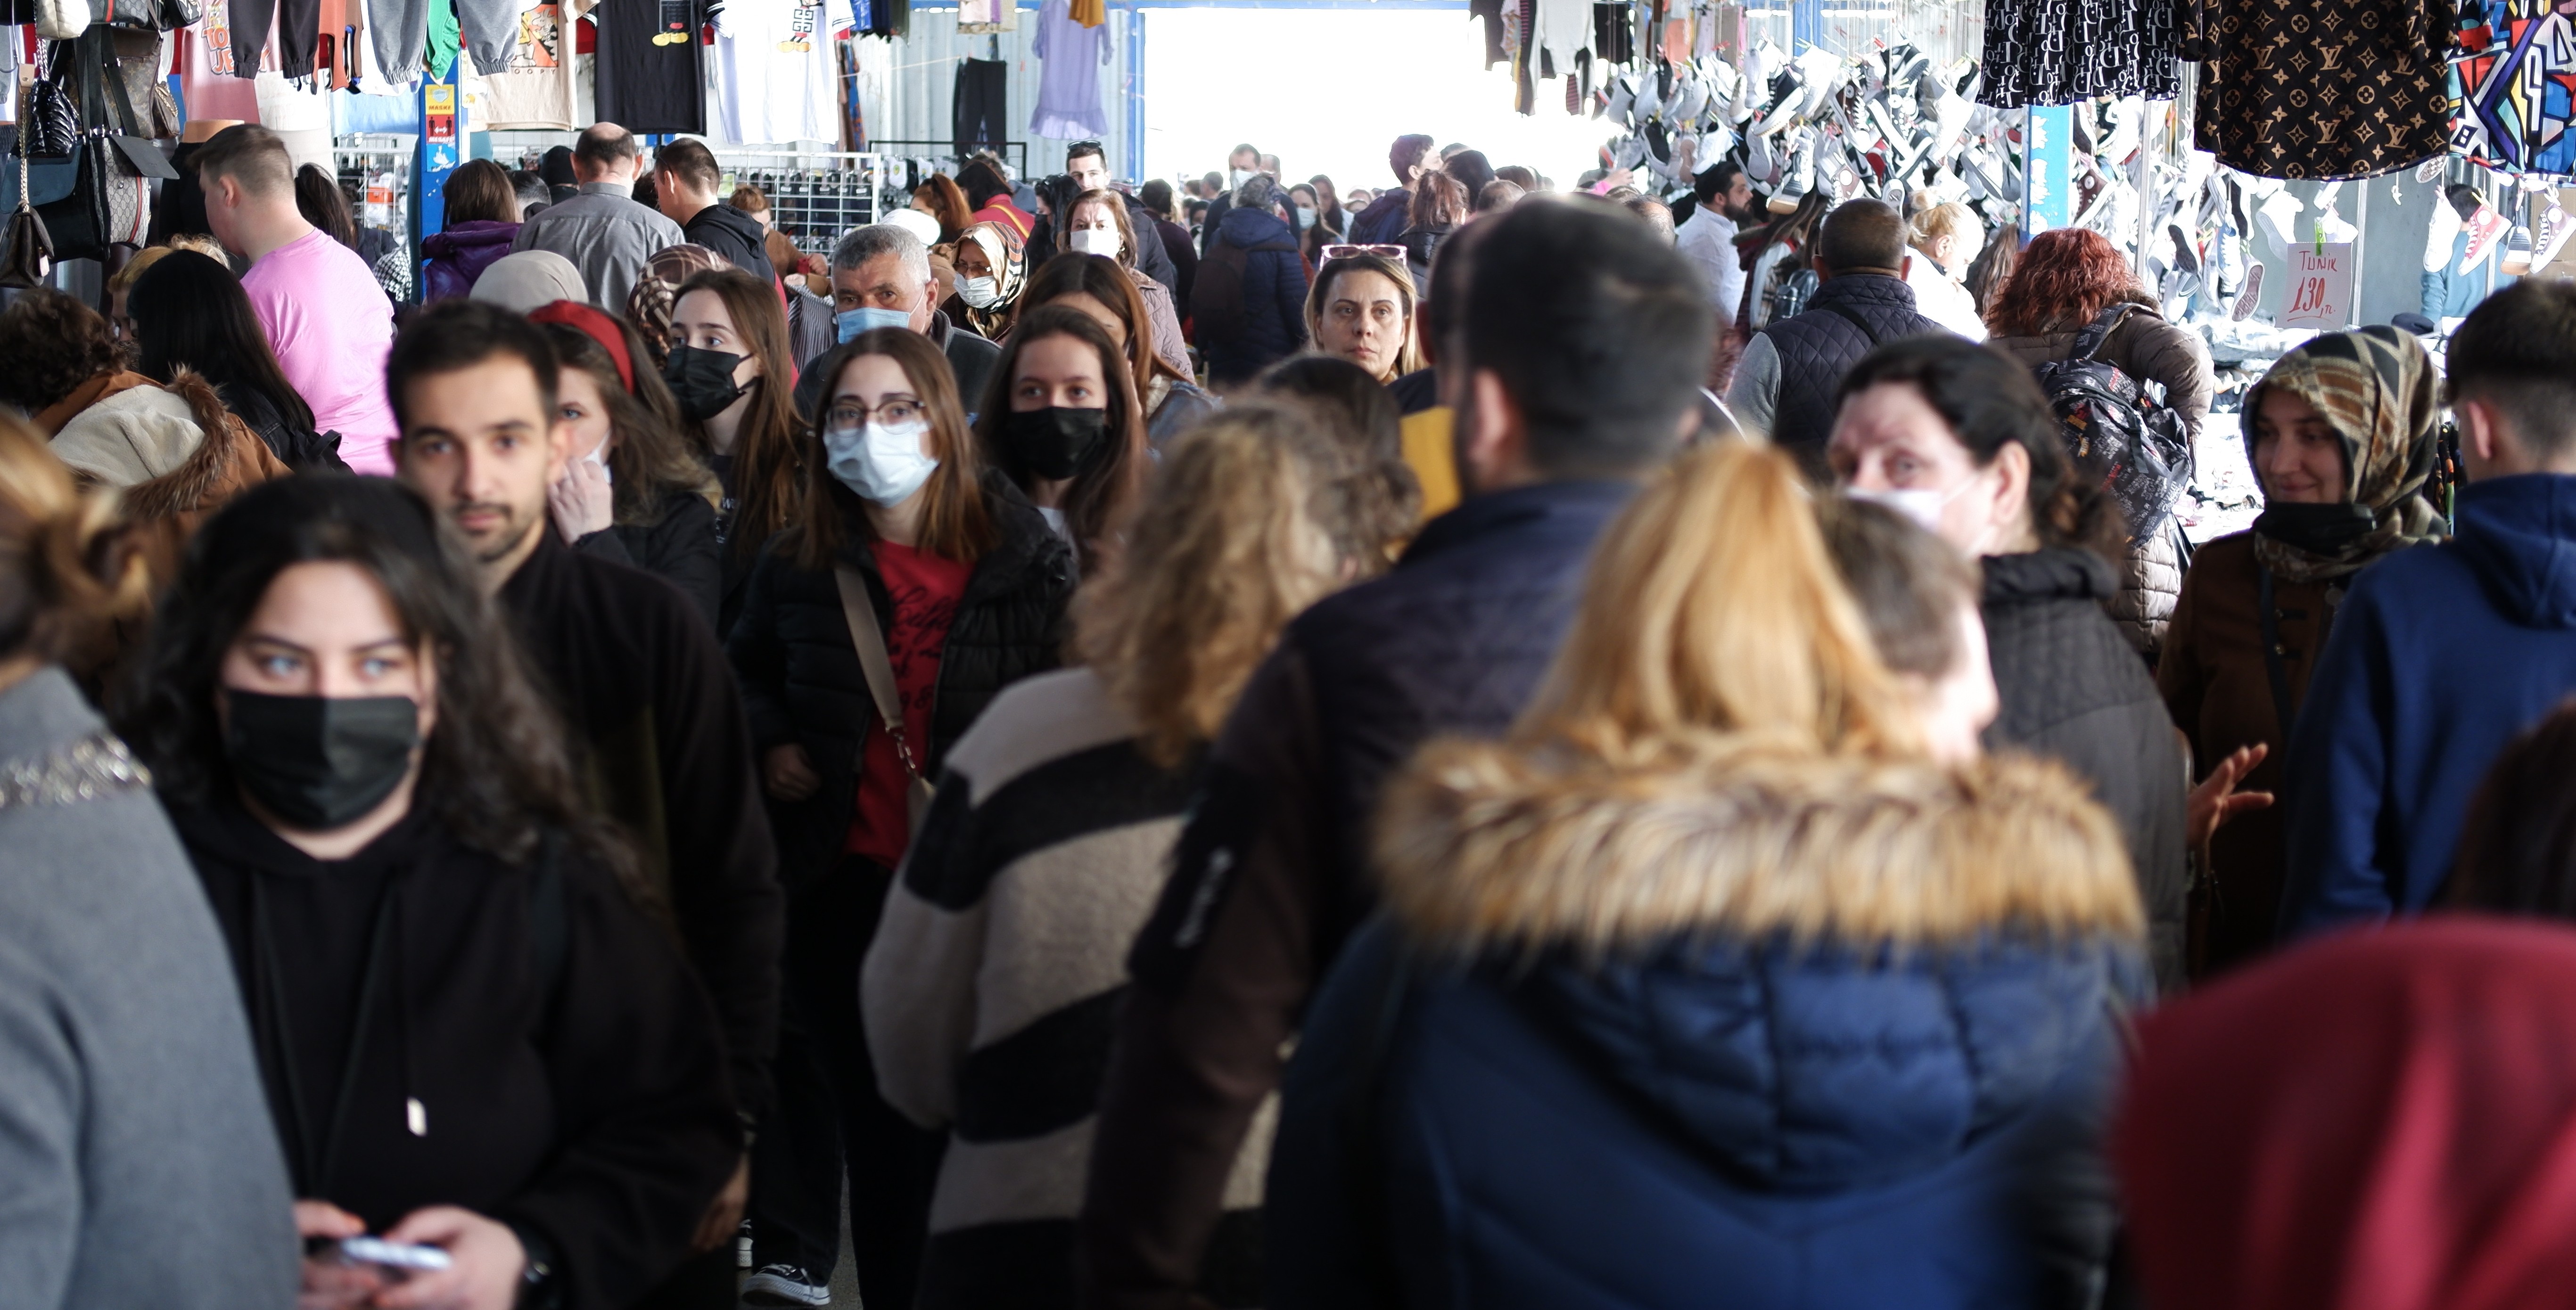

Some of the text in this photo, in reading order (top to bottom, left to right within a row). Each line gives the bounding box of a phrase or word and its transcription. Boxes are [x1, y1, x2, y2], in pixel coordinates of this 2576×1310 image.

[202, 25, 230, 51] TO
[212, 46, 270, 74] JEY
[2319, 45, 2344, 70] LV
[2253, 119, 2274, 144] LV
[2317, 119, 2341, 144] LV
[2385, 123, 2411, 149] LV
